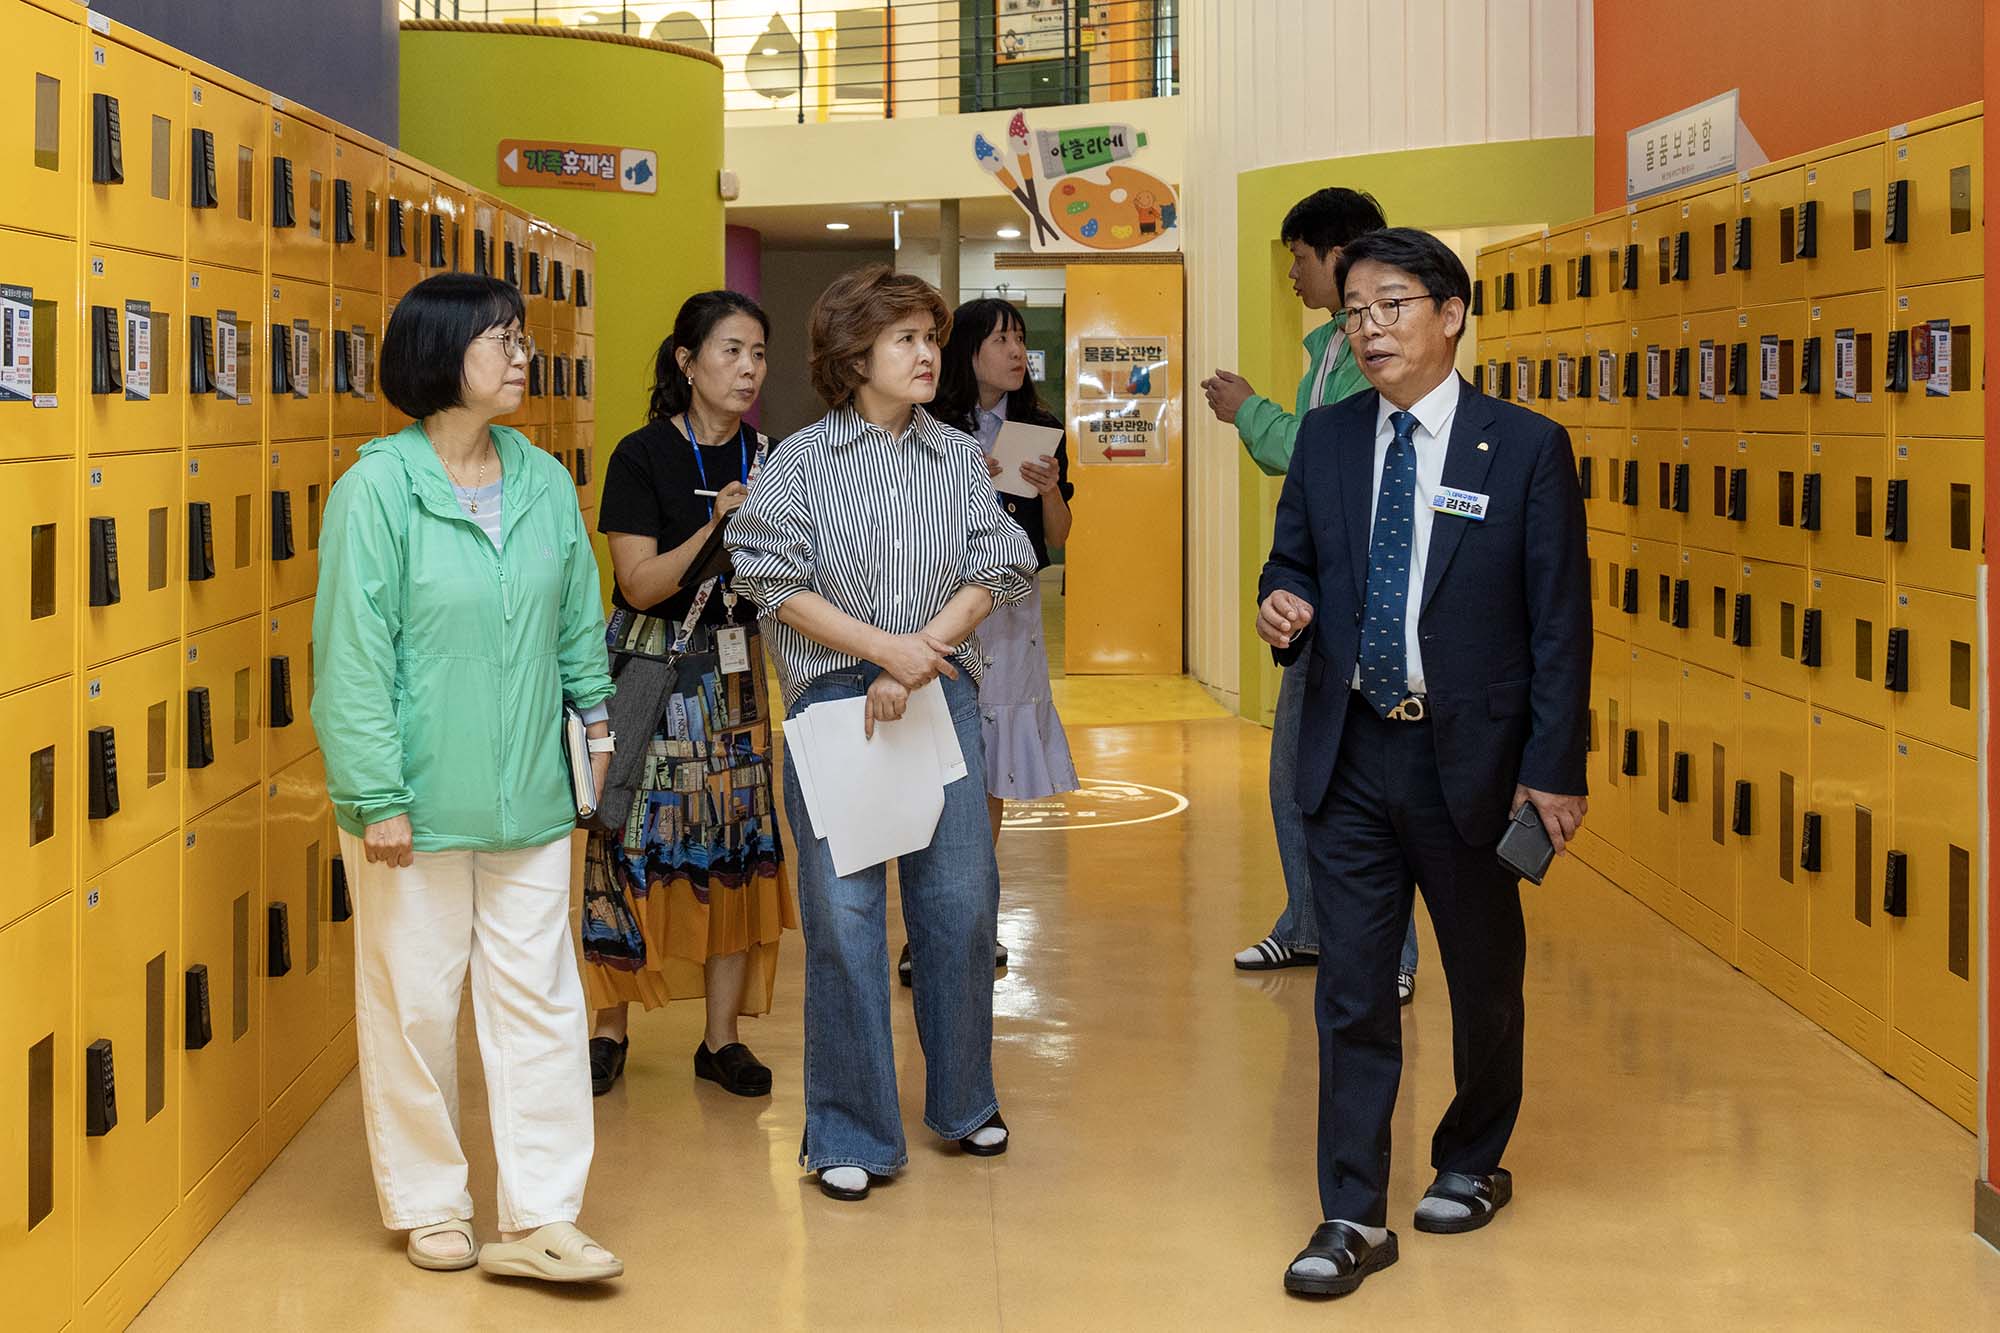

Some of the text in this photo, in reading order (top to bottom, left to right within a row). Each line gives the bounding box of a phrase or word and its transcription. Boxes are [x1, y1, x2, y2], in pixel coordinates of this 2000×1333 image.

[94, 50, 104, 63] 11
[192, 89, 202, 102] 16
[1051, 133, 1124, 160] 아뜰리에
[1646, 117, 1712, 172] 물품보관함
[523, 149, 616, 179] 가족휴게실
[93, 261, 104, 273] 12
[191, 276, 200, 286] 17
[273, 289, 280, 298] 22
[1899, 298, 1908, 307] 162
[1085, 346, 1162, 362] 물품보관함
[1098, 434, 1107, 443] 더
[190, 463, 199, 473] 18
[91, 472, 102, 484] 13
[1446, 497, 1483, 515] 김찬술
[1899, 596, 1908, 605] 164
[188, 649, 197, 660] 19
[90, 684, 100, 696] 14
[88, 892, 99, 905] 15
